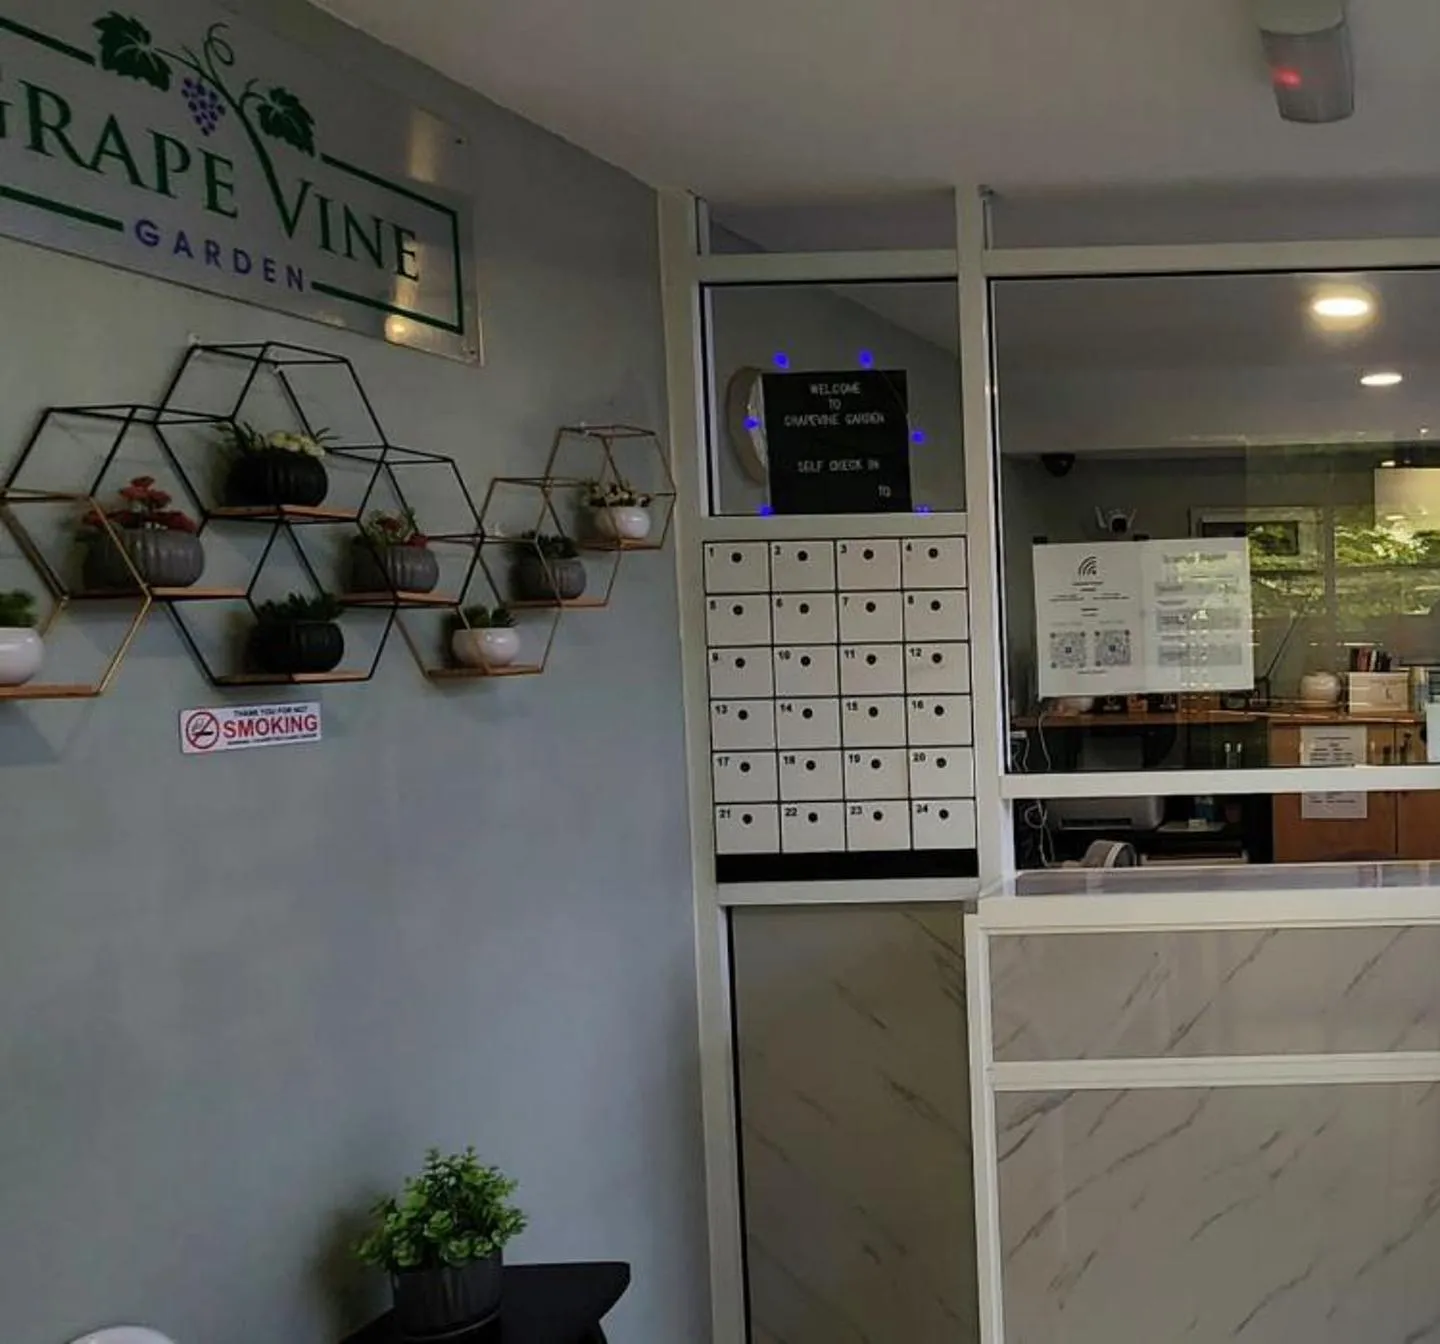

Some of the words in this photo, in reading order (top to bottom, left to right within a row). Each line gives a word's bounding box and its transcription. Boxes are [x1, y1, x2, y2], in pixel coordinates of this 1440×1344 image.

[244, 130, 420, 283] VINE
[134, 218, 304, 292] GARDEN
[808, 382, 861, 395] WELCOME
[828, 398, 842, 410] TO
[708, 547, 714, 557] 1
[906, 543, 912, 552] 4
[842, 597, 849, 606] 7
[778, 651, 791, 660] 10
[844, 649, 856, 659] 11
[910, 648, 922, 657] 12
[715, 705, 728, 715] 13
[780, 704, 793, 713] 14
[846, 702, 858, 712] 15
[912, 700, 924, 710] 16
[223, 714, 318, 739] SMOKING
[717, 757, 730, 767] 17
[783, 756, 796, 765] 18
[849, 754, 861, 764] 19
[913, 753, 926, 763] 20
[719, 809, 731, 819] 21
[784, 808, 798, 817] 22
[850, 806, 863, 815] 23
[916, 804, 929, 814] 24
